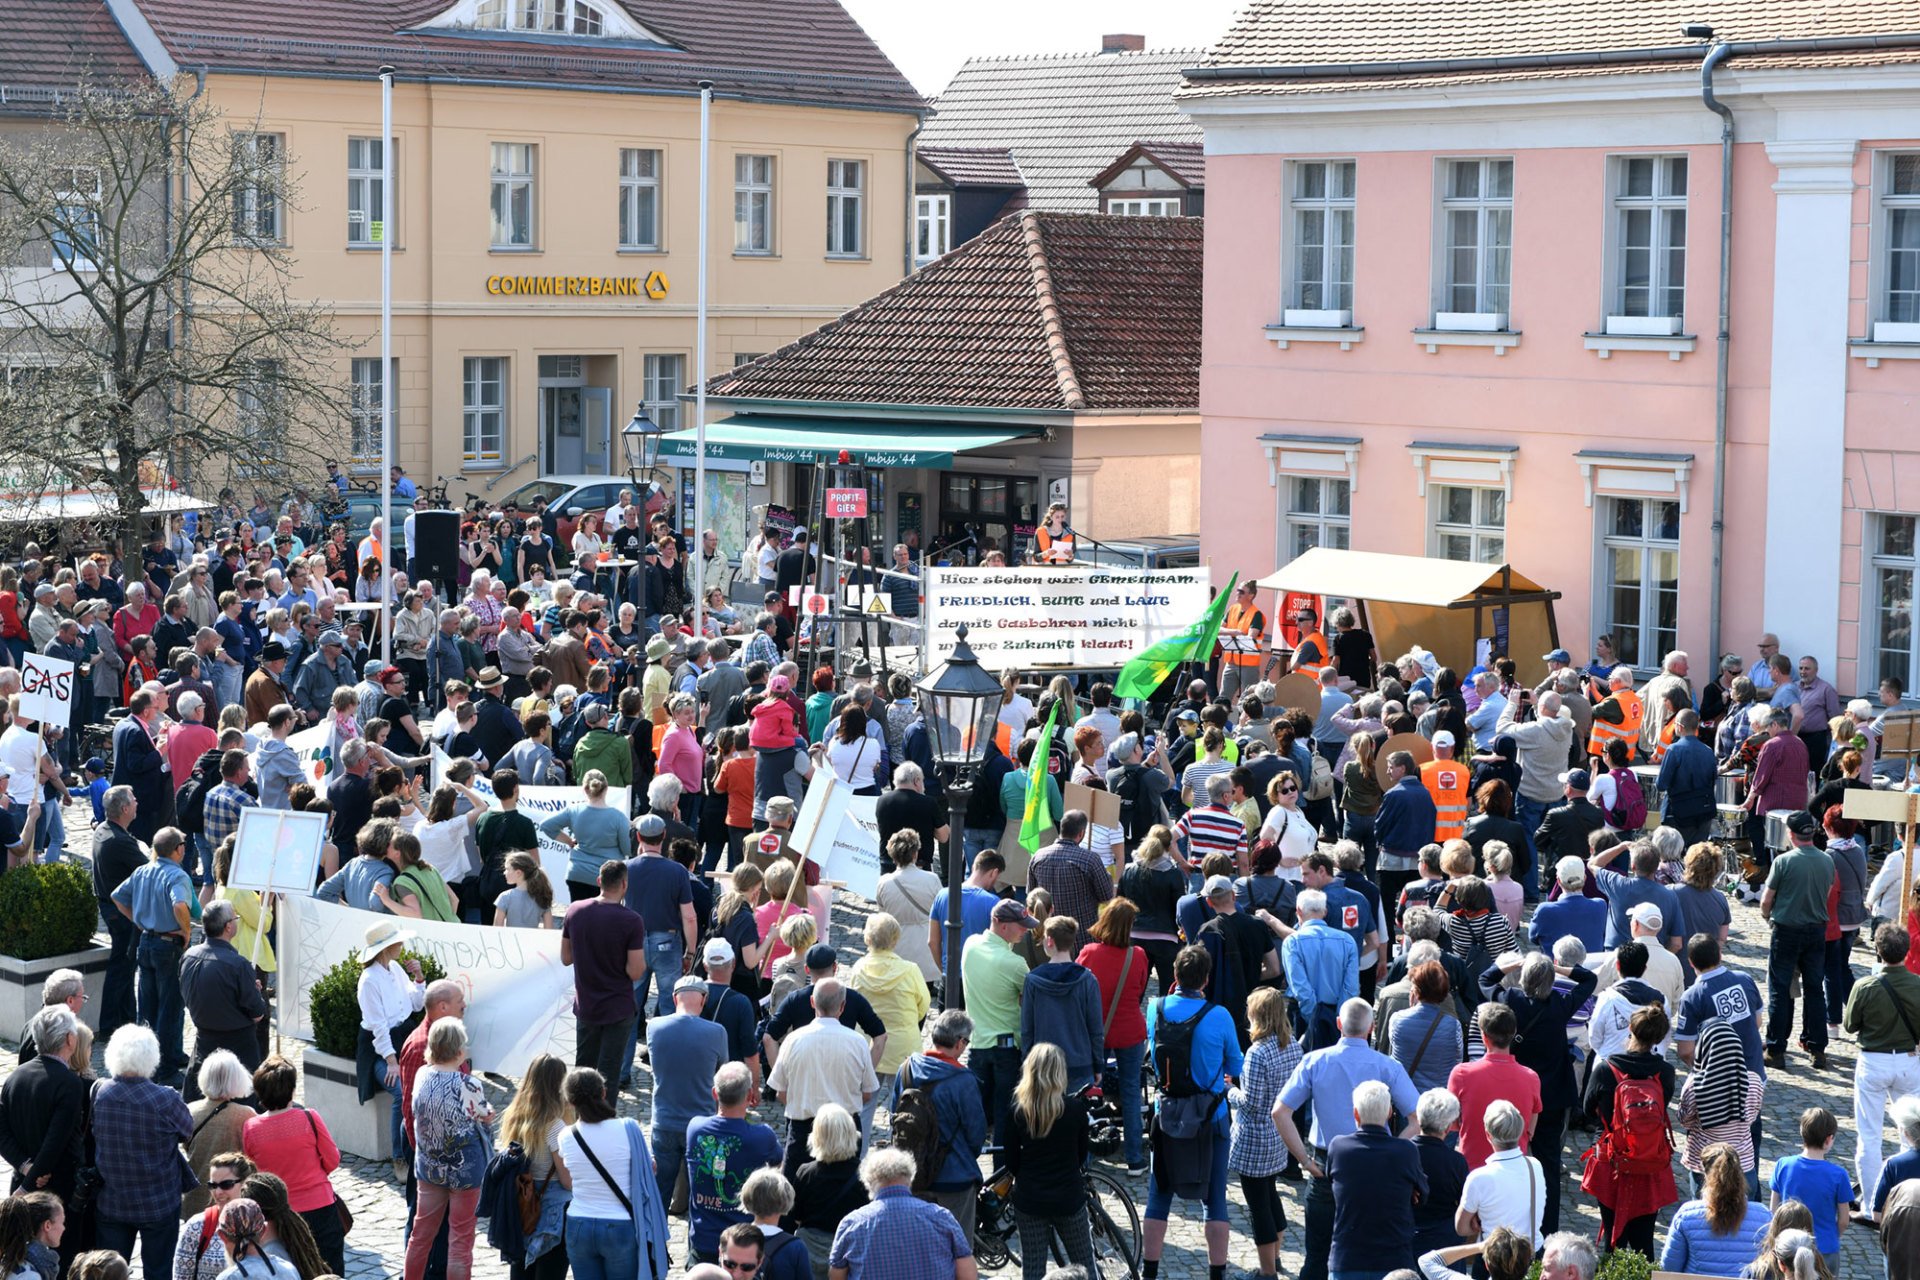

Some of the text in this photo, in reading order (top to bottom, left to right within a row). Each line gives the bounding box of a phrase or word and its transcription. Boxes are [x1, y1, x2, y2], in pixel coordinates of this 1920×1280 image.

[487, 275, 640, 296] COMMERZBANK
[763, 448, 796, 461] Imbiss
[830, 493, 862, 502] PROFIT-
[836, 504, 856, 513] GIER
[940, 574, 979, 585] Hier
[983, 574, 1043, 585] stehen
[1047, 574, 1083, 584] wir:
[1041, 596, 1085, 606] BUNT
[1090, 596, 1120, 606] und
[1125, 596, 1170, 606] LAUT
[997, 617, 1088, 629] Gasbohren
[1092, 617, 1138, 628] nicht
[1002, 639, 1075, 650] Zukunft
[1081, 639, 1133, 650] klaut!
[22, 666, 69, 701] GAS
[1716, 988, 1748, 1018] 63
[696, 1193, 722, 1207] DIVE
